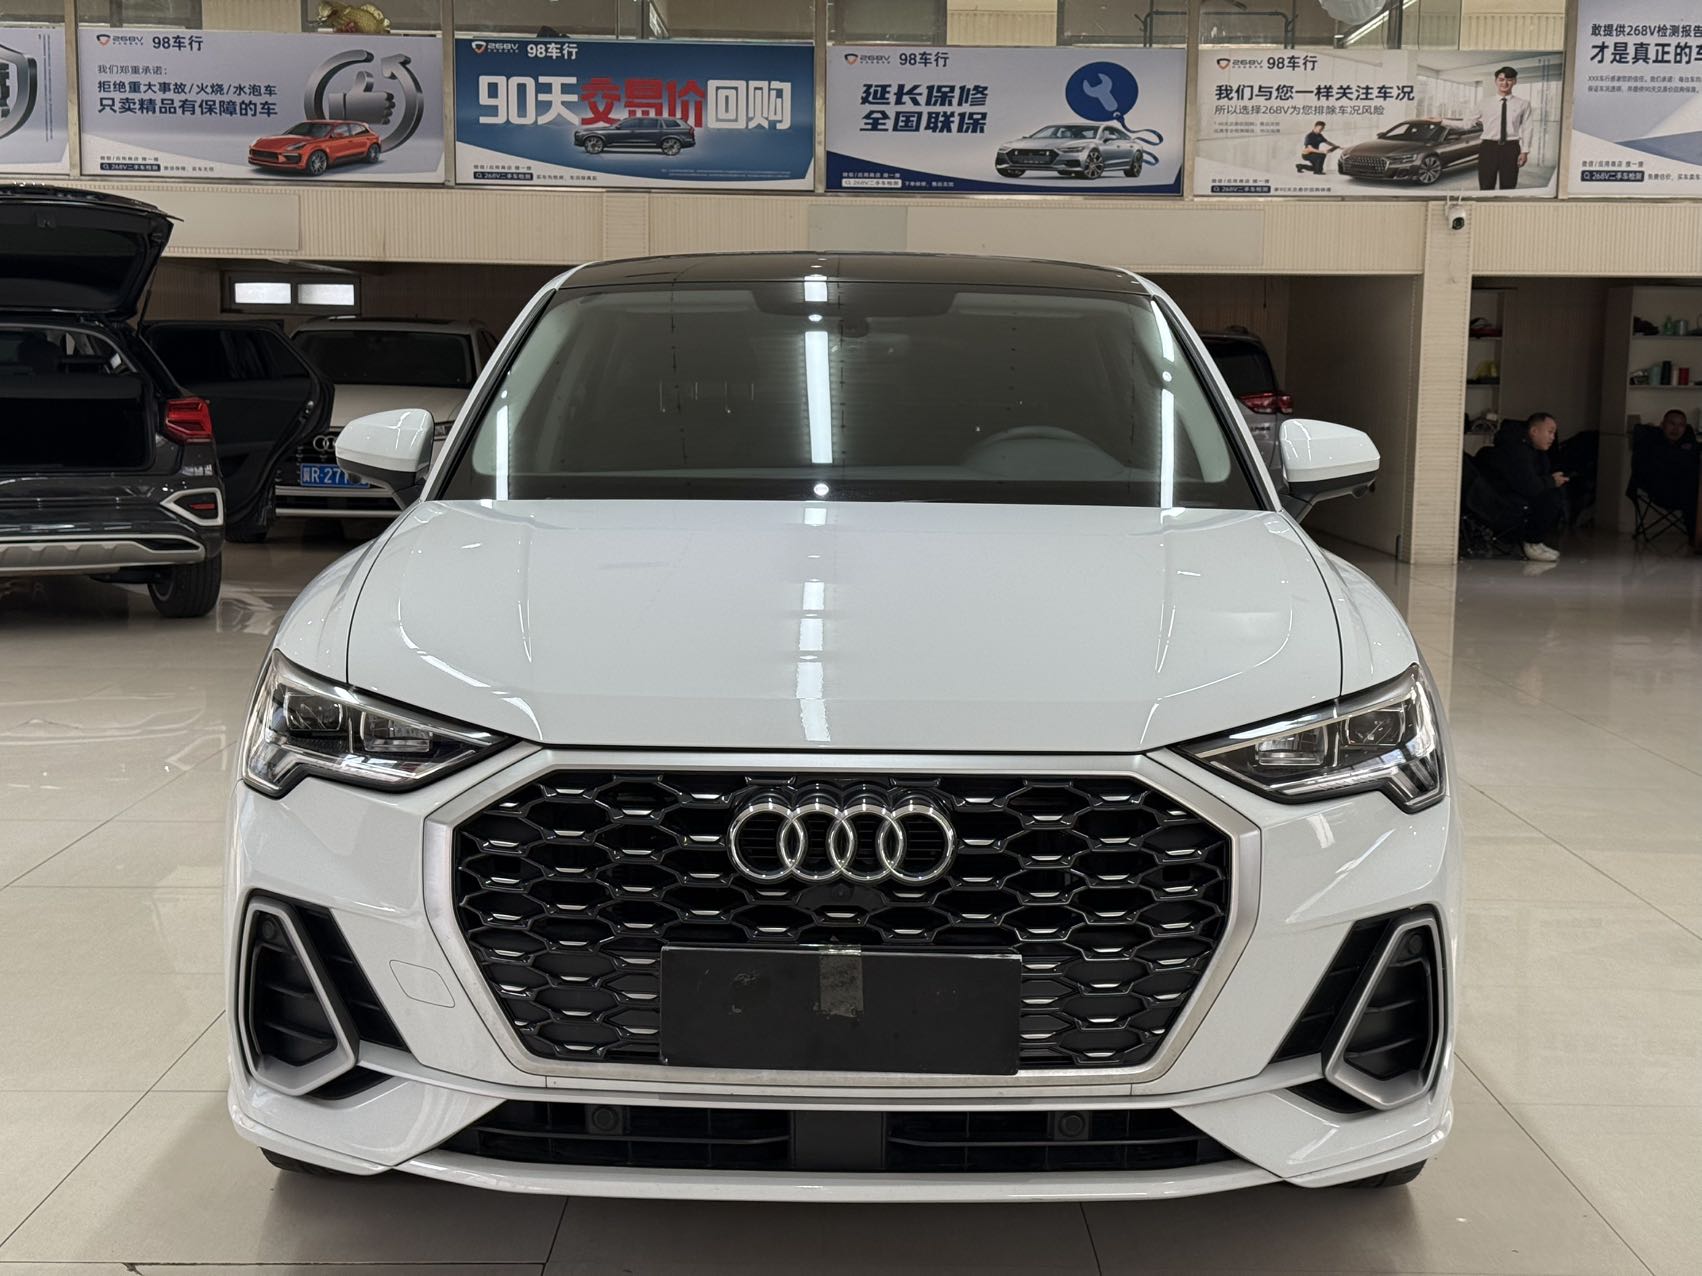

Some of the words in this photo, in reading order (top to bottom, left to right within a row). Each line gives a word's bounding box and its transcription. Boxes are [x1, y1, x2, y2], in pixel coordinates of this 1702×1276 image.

[1591, 24, 1702, 37] 敢提供268V检测报告
[152, 35, 203, 52] 98车行
[527, 43, 578, 60] 98车行
[899, 52, 949, 68] 98车行
[1267, 55, 1318, 71] 98车行
[97, 80, 277, 98] 拒绝重大事故/火烧/水泡车
[860, 84, 988, 106] 延长保修
[1214, 84, 1415, 102] 我们与您一样关注车况
[98, 97, 278, 118] 只卖精品有保障的车
[478, 75, 791, 130] 90天交易价回购
[1214, 105, 1385, 116] 所以选择268V为您排除车况风险
[859, 110, 987, 133] 全国联保
